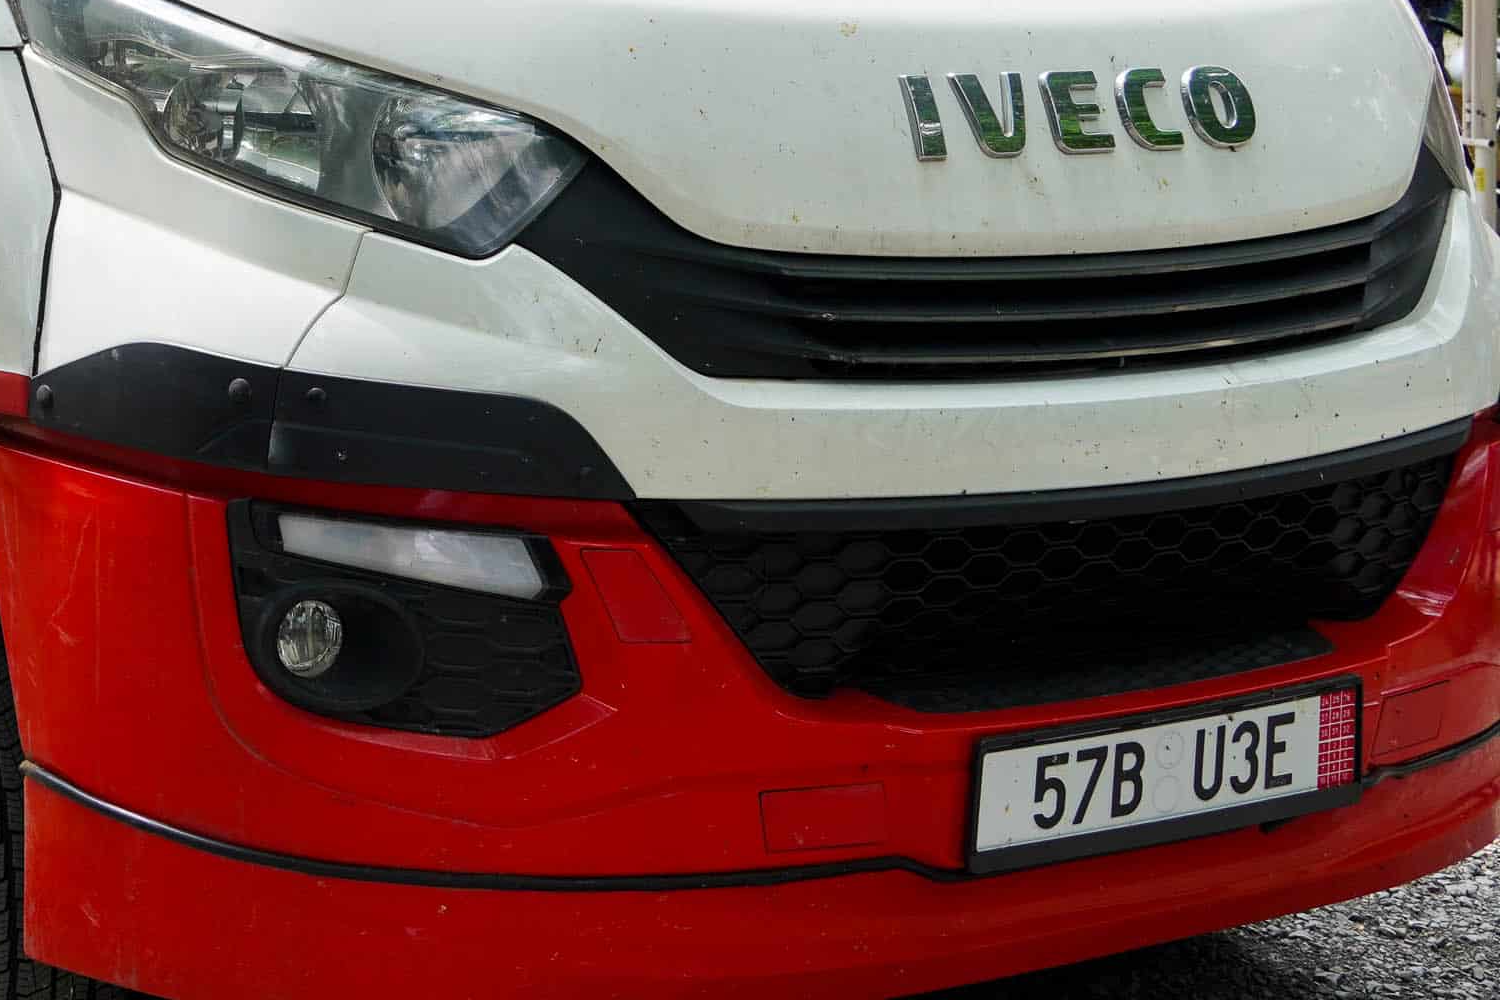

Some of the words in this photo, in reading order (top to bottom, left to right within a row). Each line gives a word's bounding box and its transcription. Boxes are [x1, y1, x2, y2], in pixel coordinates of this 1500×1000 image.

[898, 64, 1257, 162] IVECO
[1033, 741, 1145, 829] 57B
[1193, 712, 1295, 801] U3E
